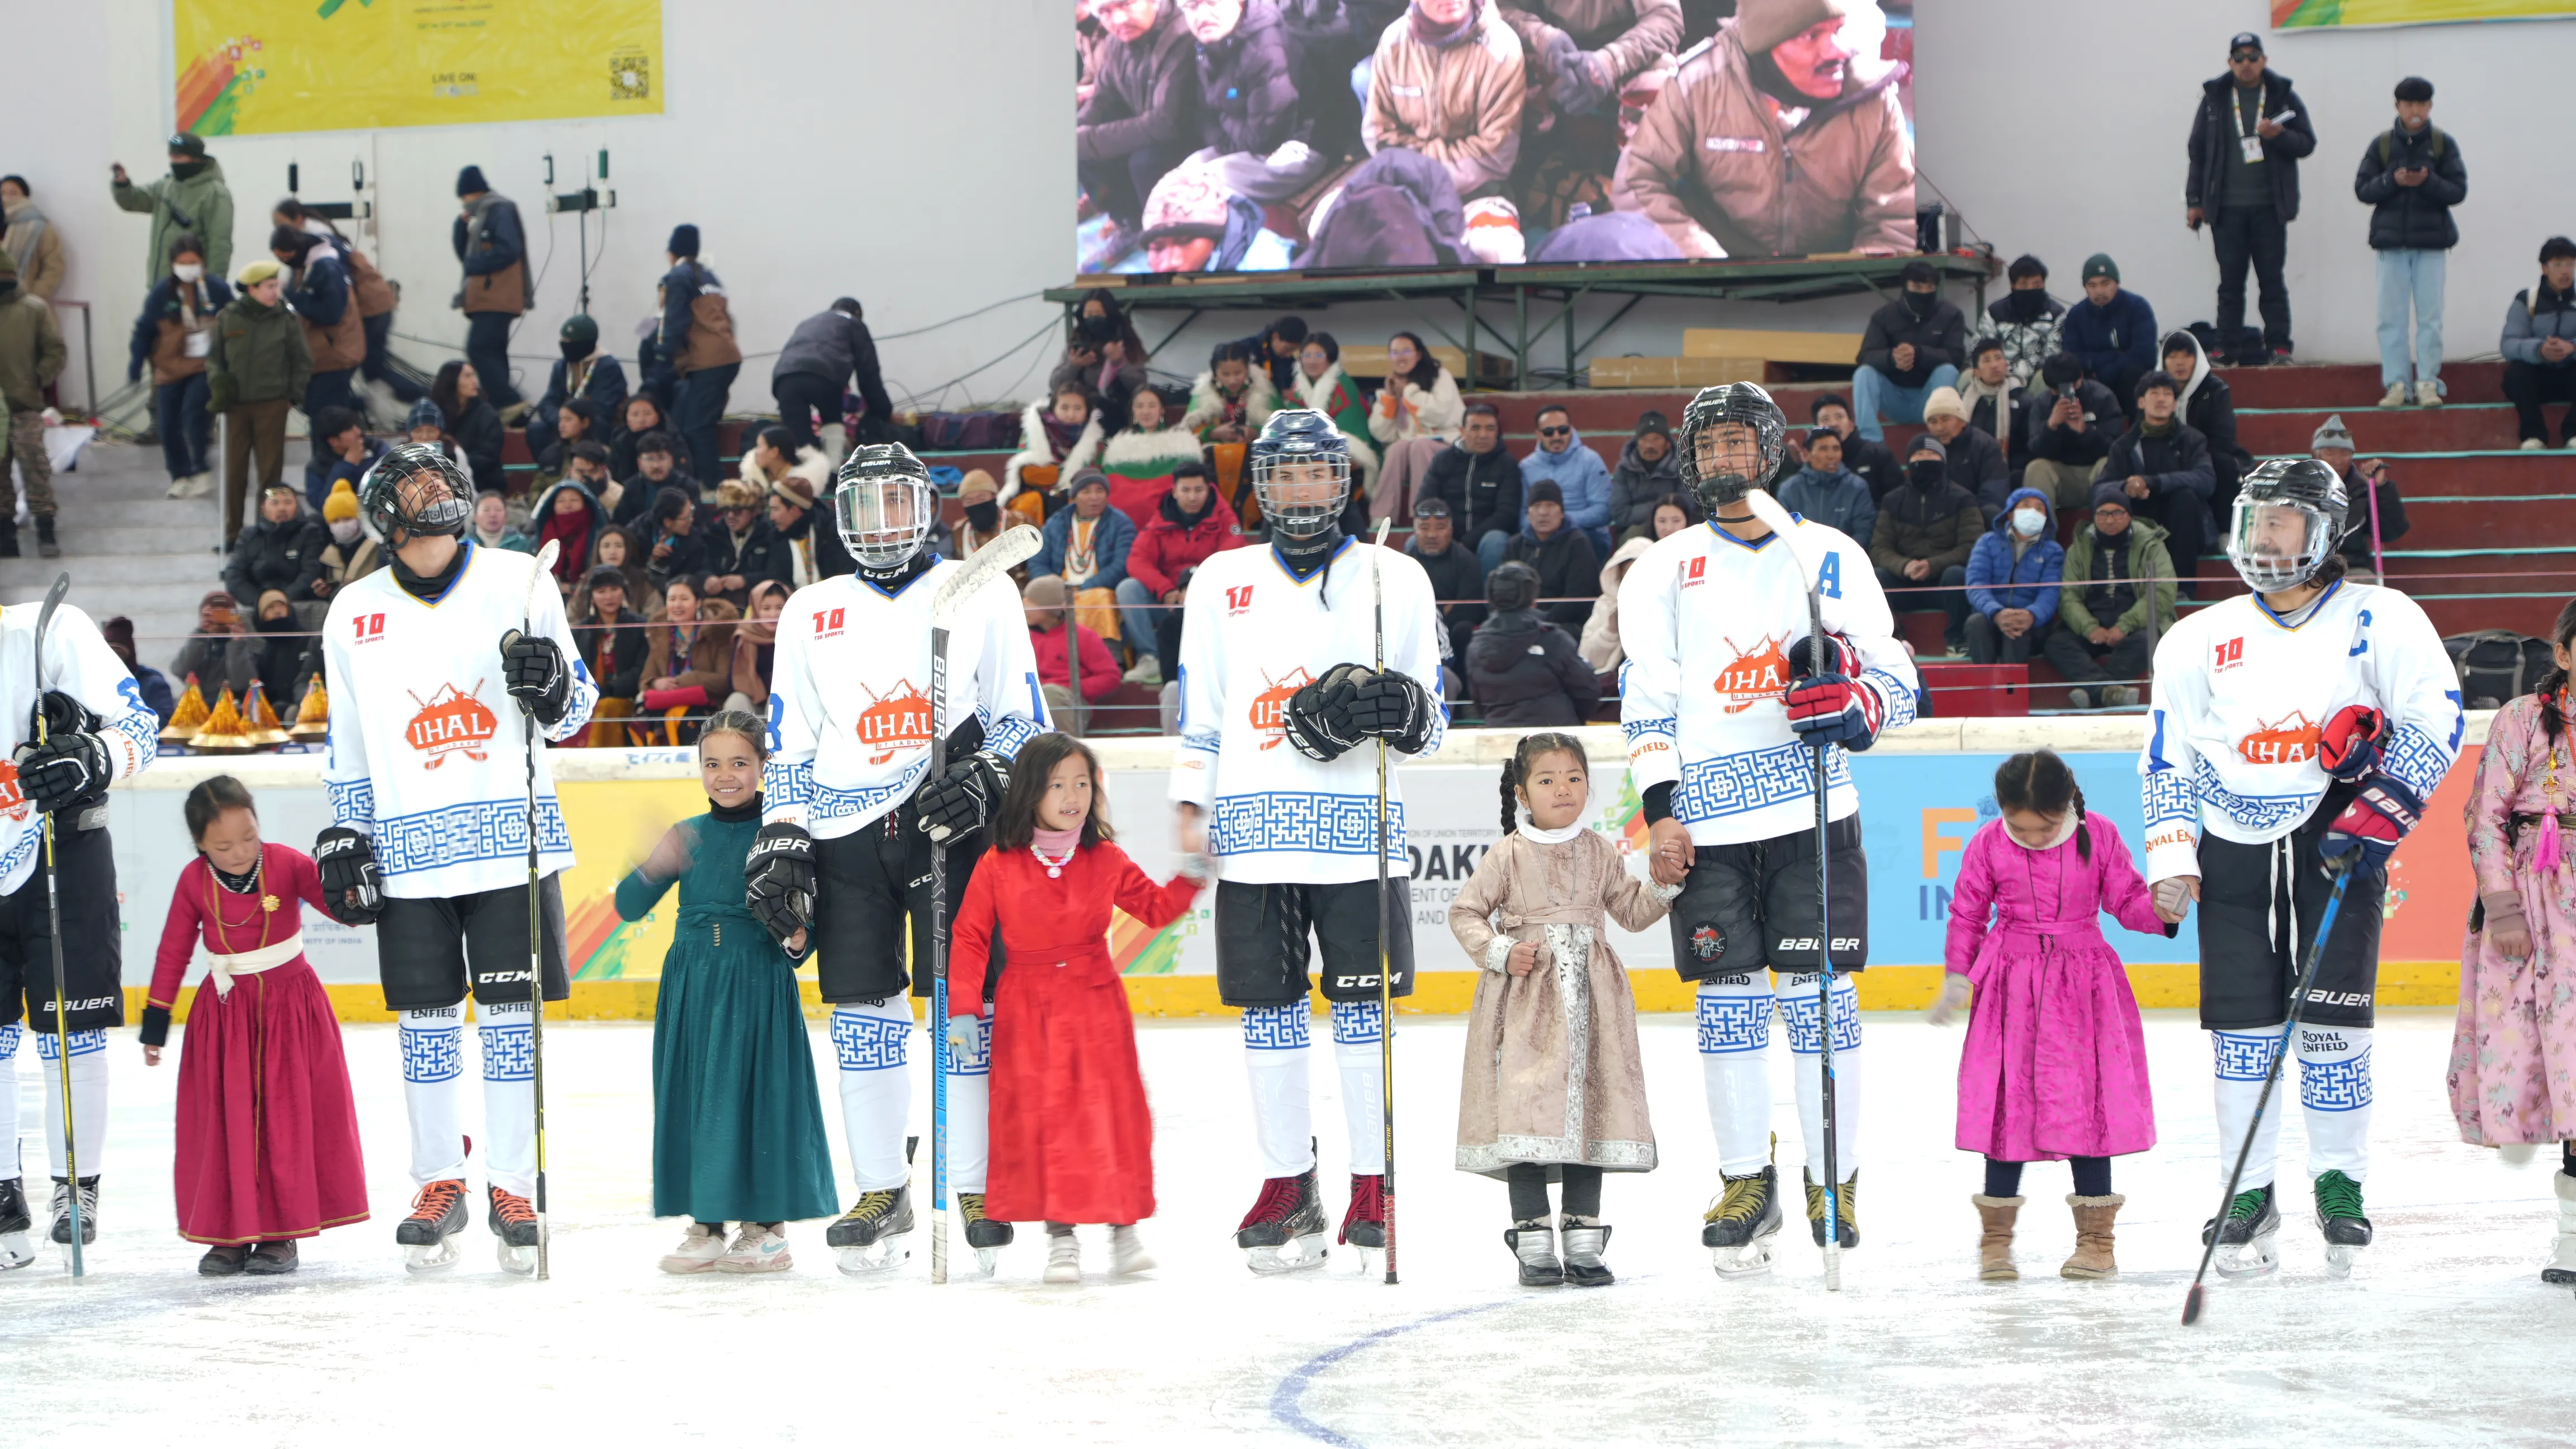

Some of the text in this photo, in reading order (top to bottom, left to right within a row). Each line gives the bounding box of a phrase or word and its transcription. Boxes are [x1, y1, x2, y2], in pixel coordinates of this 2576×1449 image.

[432, 73, 455, 84] LIVE
[1698, 398, 1727, 408] BAUER
[863, 561, 910, 580] CCM
[1819, 551, 1843, 600] A
[1684, 579, 1705, 589] SPORTS
[365, 635, 385, 643] SPORTS
[825, 630, 844, 638] SPORTS
[2348, 609, 2373, 657] C
[934, 654, 946, 741] BAUER
[1751, 690, 1786, 698] LADAK
[1256, 699, 1285, 724] IH
[413, 712, 491, 745] IHAL
[863, 712, 932, 739] IHAL
[1283, 697, 1326, 760] BAUE
[1628, 741, 1669, 767] ENFIELD
[2361, 787, 2419, 832] BAUE
[1433, 828, 1454, 838] UNION
[1457, 828, 1497, 838] TERRITORY
[746, 837, 811, 865] BAUER
[908, 873, 932, 888] CC
[1418, 910, 1446, 925] AND
[478, 970, 532, 984] CCM
[1336, 972, 1403, 988] CCM
[44, 996, 114, 1012] BAUER
[490, 1002, 533, 1016] ENFIEL
[411, 1008, 457, 1019] ENFIELD
[2302, 1030, 2342, 1042] ROYAL
[2302, 1041, 2348, 1053] ENFIELD
[937, 1124, 946, 1201] NEXUS
[1291, 1210, 1307, 1228] CCM
